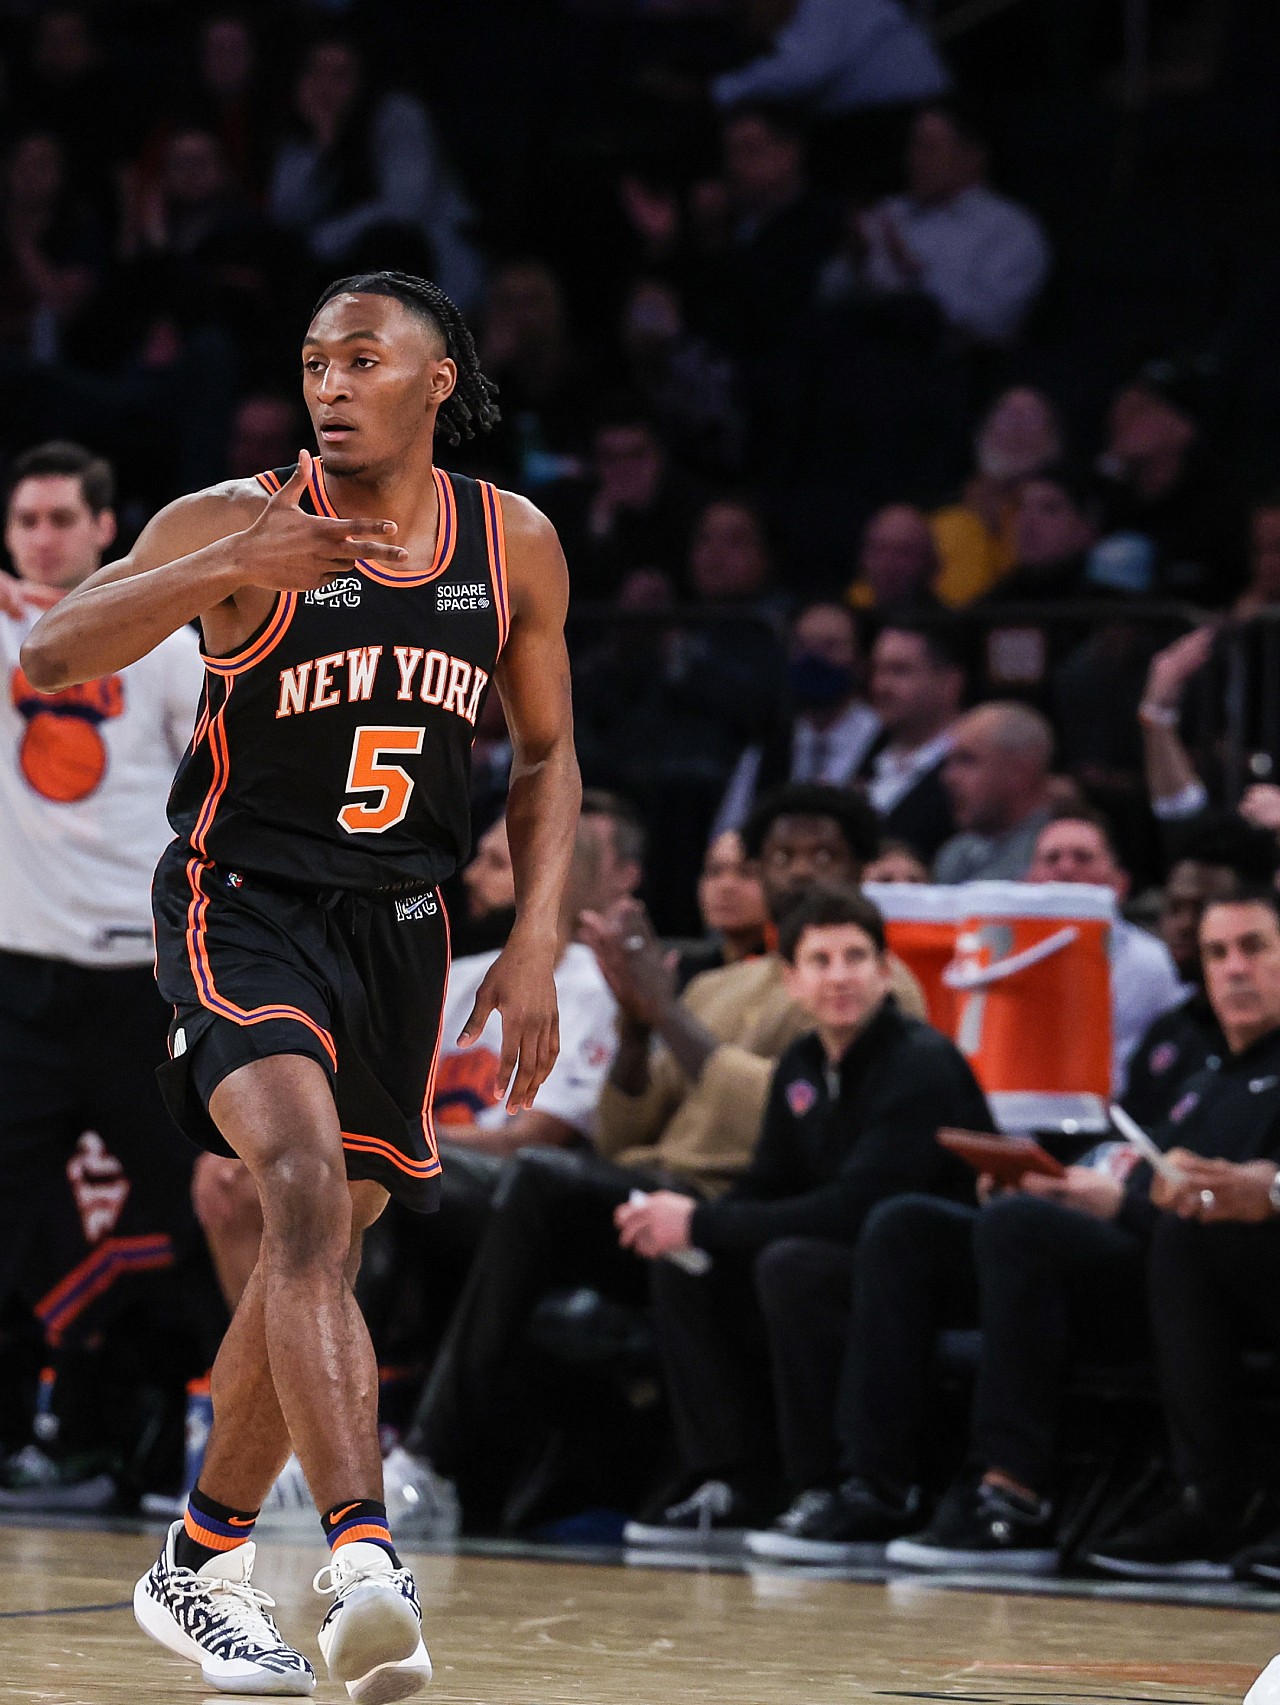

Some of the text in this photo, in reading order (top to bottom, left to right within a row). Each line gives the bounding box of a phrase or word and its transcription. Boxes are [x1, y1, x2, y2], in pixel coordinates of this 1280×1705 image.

[436, 597, 478, 611] SPACE
[437, 583, 487, 598] SQUARE
[275, 645, 489, 727] NEW YORK
[336, 725, 426, 834] 5
